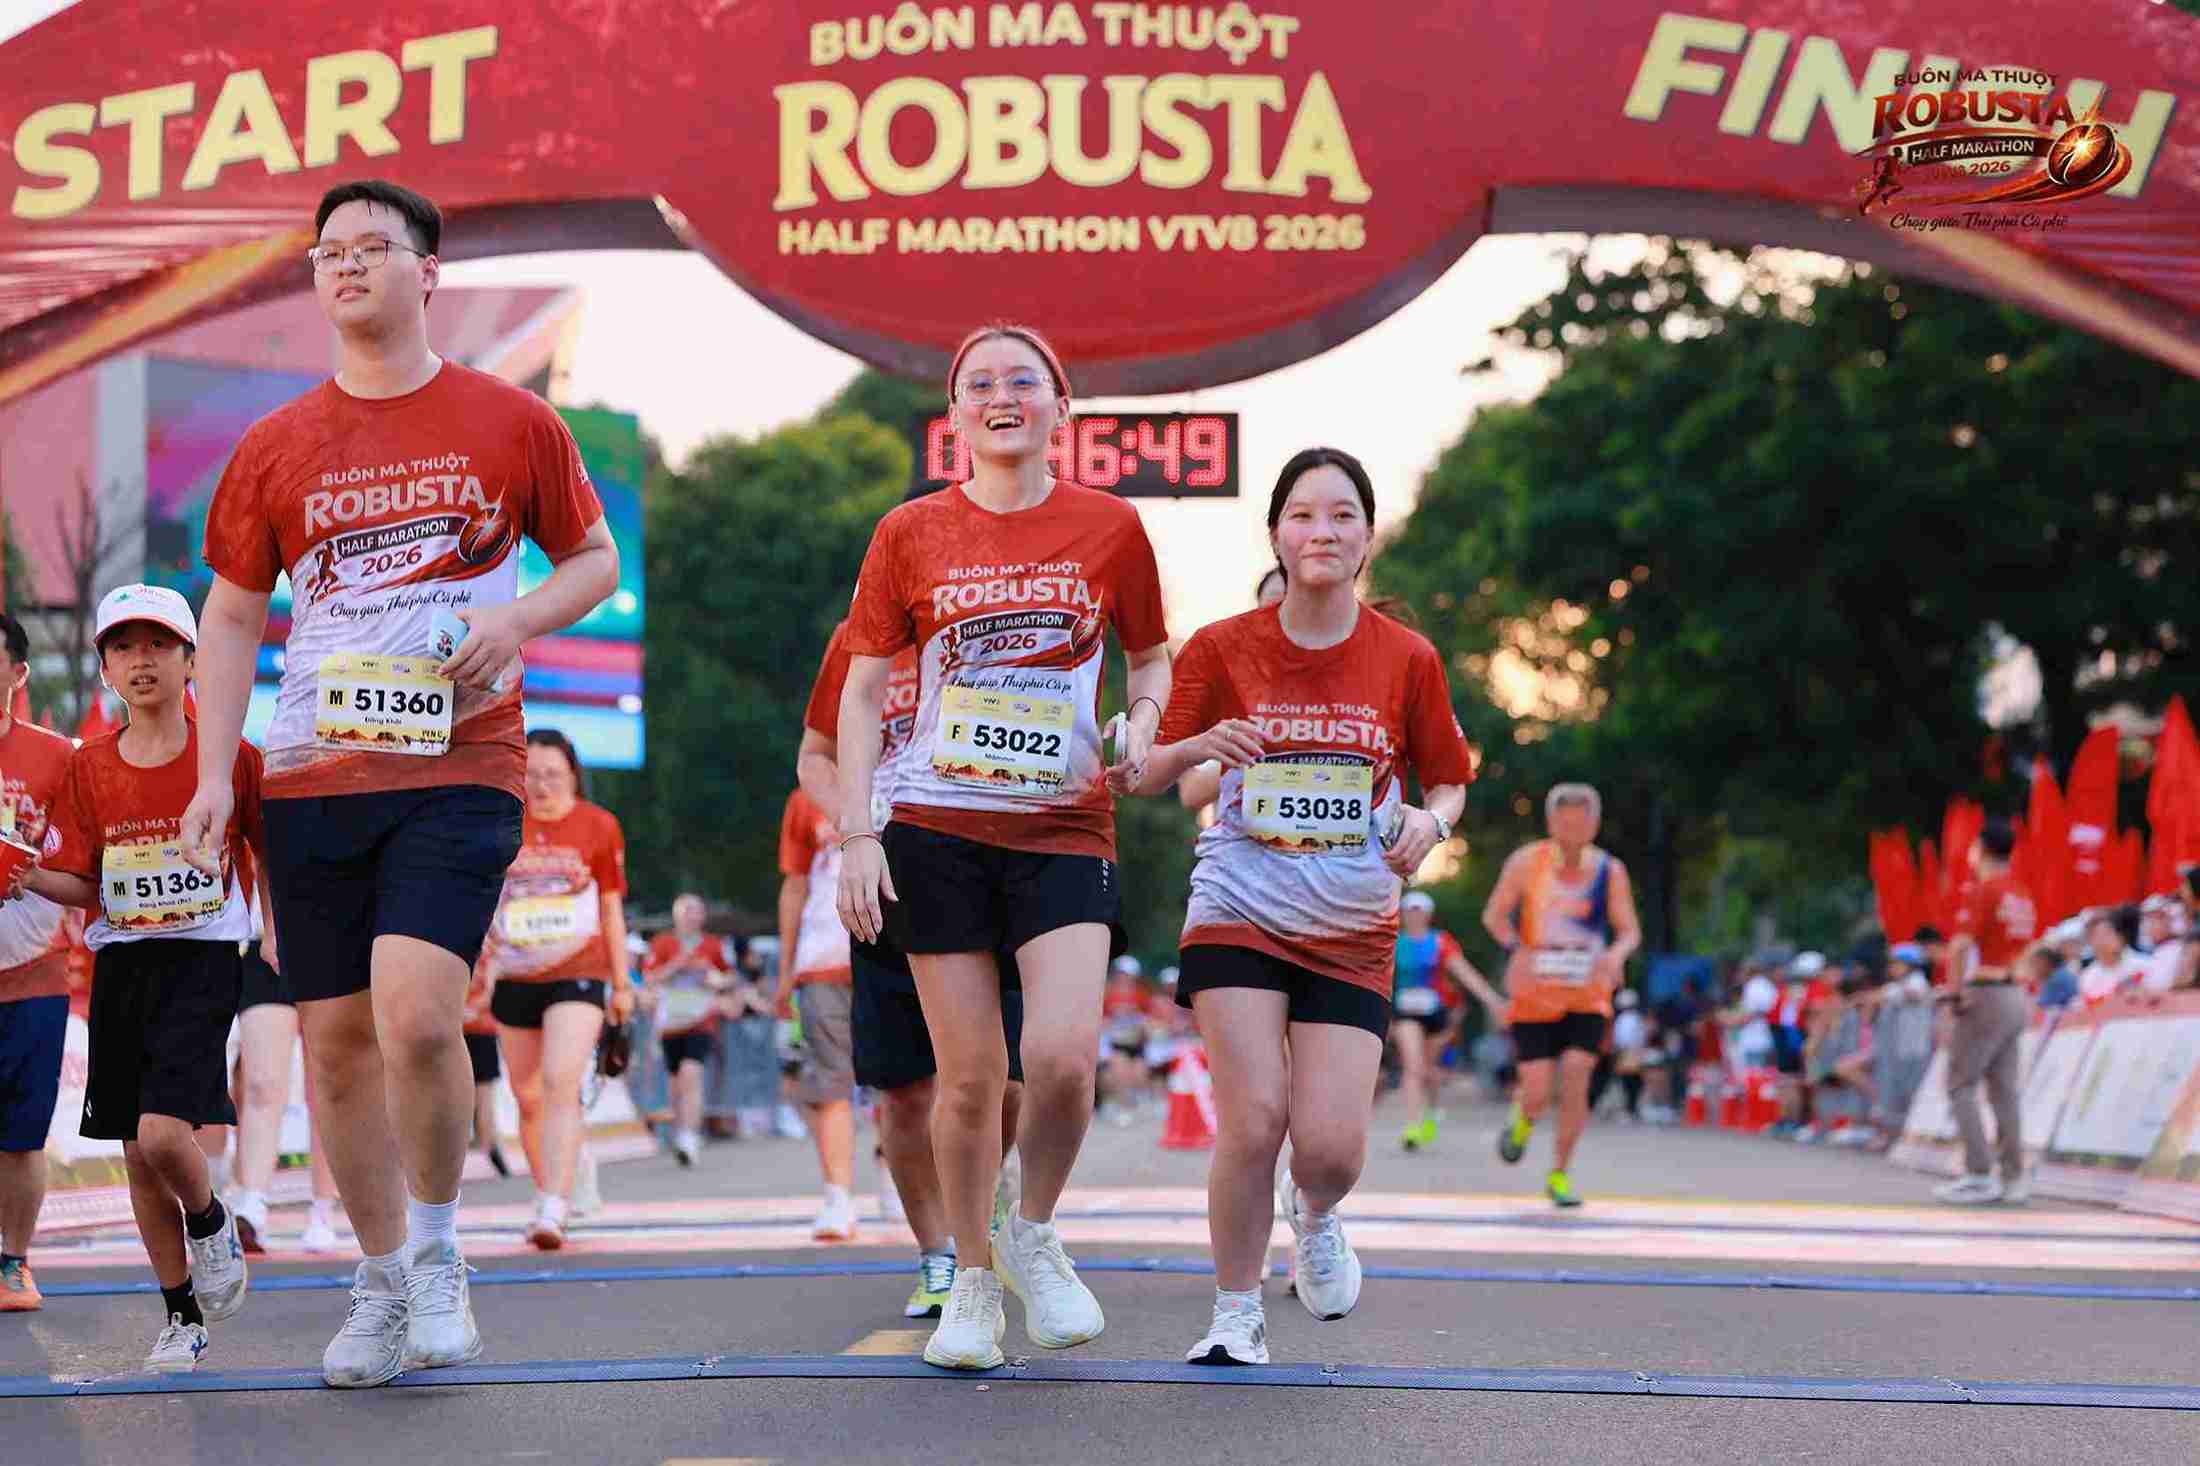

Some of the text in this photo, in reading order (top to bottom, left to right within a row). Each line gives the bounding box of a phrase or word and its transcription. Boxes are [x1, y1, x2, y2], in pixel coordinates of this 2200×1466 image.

[809, 2, 1300, 66] BUÔN MA THUỘT
[10, 25, 499, 220] START
[772, 69, 1373, 212] ROBUSTA
[778, 213, 1367, 254] HALF MARATHON VTV8 2026
[320, 452, 471, 487] BUÔN MA THUỘT
[303, 474, 486, 539] ROBUSTA
[340, 519, 450, 555] HALF MARATHON
[360, 544, 423, 578] 2026
[948, 560, 1083, 580] BUÔN MA THUỘT
[931, 576, 1092, 623] ROBUSTA
[963, 614, 1064, 637] HALF MARATHON
[979, 632, 1038, 656] 2026
[329, 687, 445, 717] M 51360
[1256, 702, 1301, 715] BUÔN
[1304, 703, 1329, 715] MA
[952, 724, 961, 740] F
[972, 724, 1062, 758] 53022
[145, 818, 168, 831] MA
[1257, 796, 1362, 821] F 53038
[112, 881, 127, 897] M
